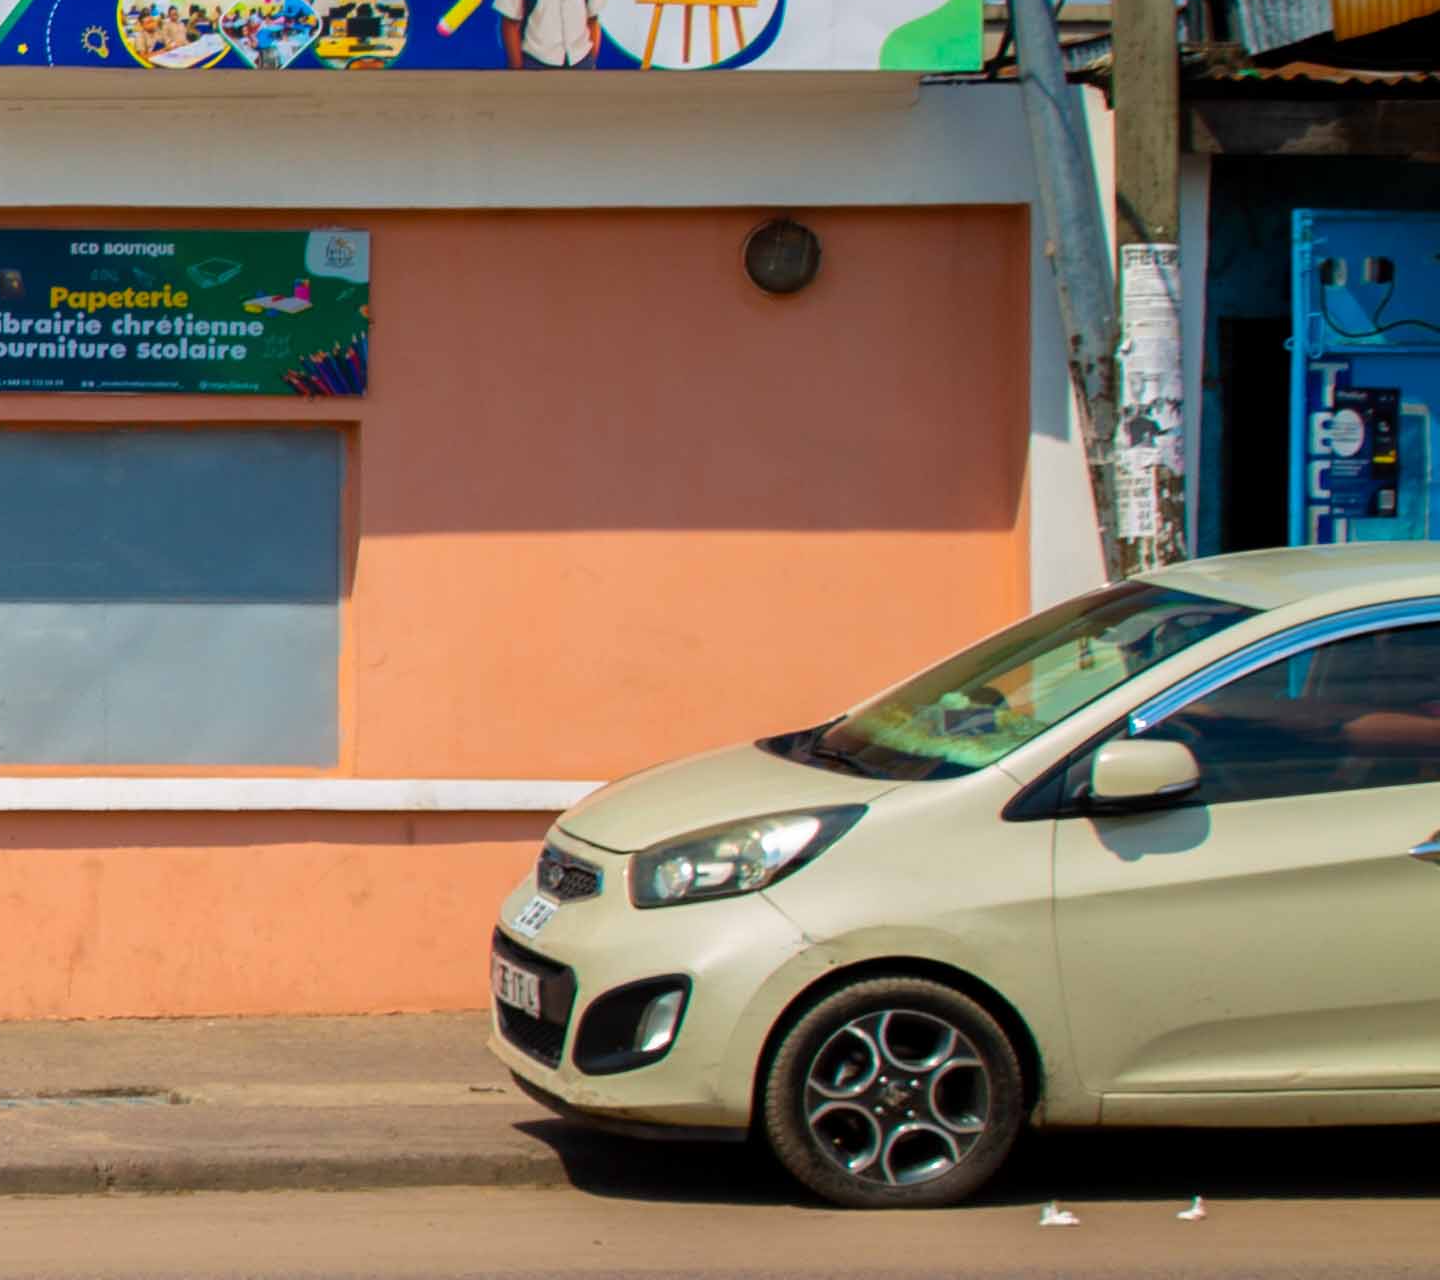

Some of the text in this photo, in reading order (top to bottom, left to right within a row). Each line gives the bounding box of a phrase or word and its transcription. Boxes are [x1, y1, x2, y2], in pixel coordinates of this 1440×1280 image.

[70, 242, 176, 256] ECD BOUTIQUE
[49, 284, 189, 313] Papeterie
[111, 313, 265, 336] chrétienne
[136, 336, 247, 360] scolaire
